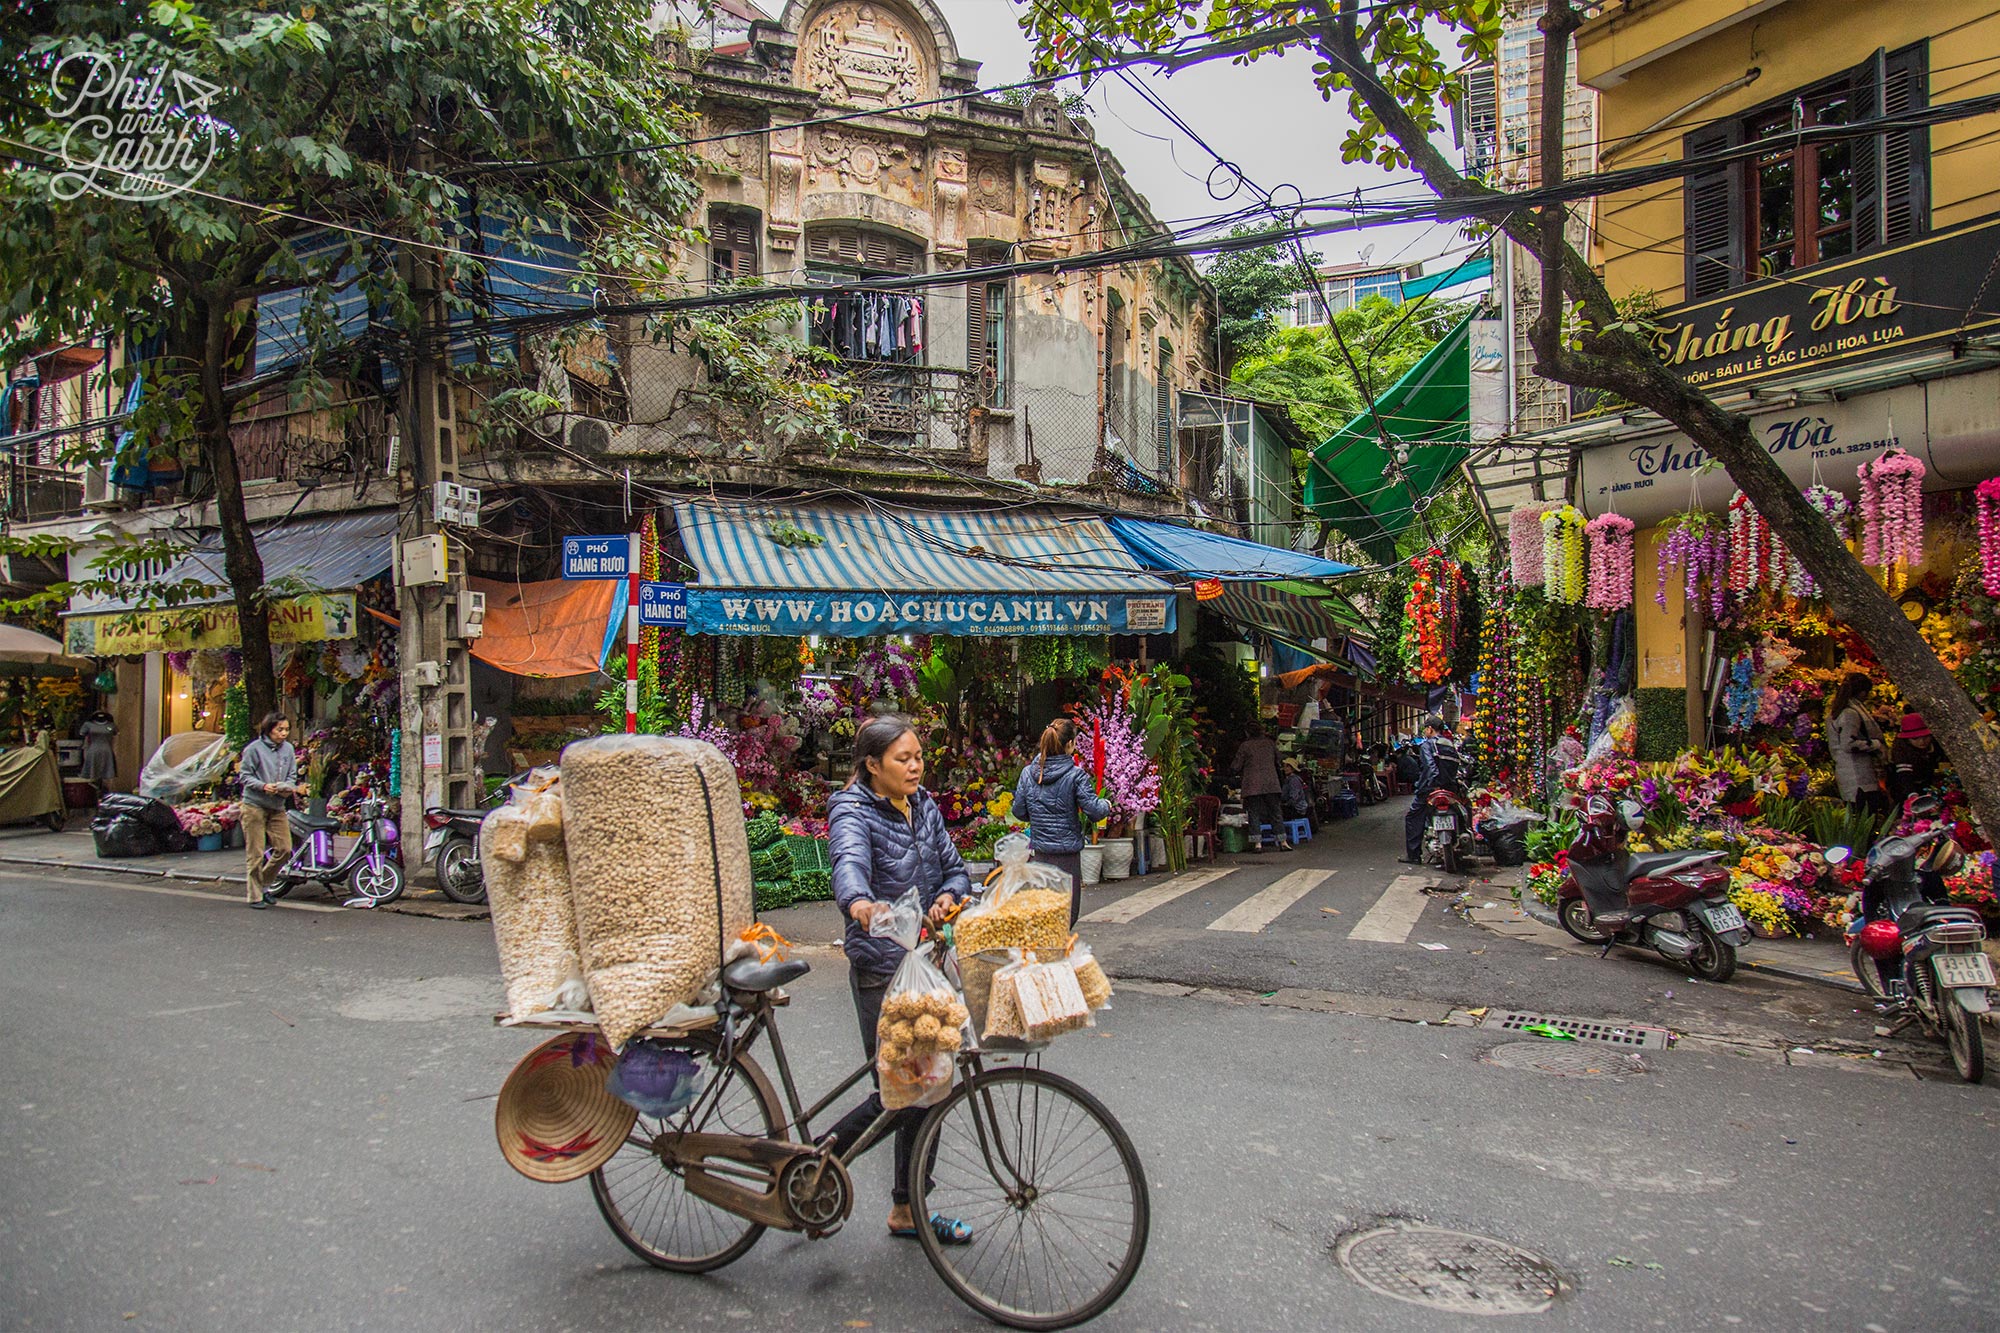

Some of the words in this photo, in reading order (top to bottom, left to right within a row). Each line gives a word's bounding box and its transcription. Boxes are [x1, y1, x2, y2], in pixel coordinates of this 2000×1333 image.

[1650, 306, 1794, 366] Thắng
[1808, 277, 1901, 331] Hà
[1716, 363, 1743, 378] BÁN
[1746, 354, 1763, 371] LẺ
[1768, 350, 1797, 367] CÁC
[1800, 341, 1833, 360] LOẠI
[1837, 335, 1867, 351] HOA
[1873, 325, 1904, 344] LỤA
[1766, 417, 1837, 454] Hà
[1846, 442, 1871, 453] 3829
[586, 541, 609, 553] PHỐ
[569, 555, 598, 573] HÀNG
[660, 589, 681, 601] PHỐ
[644, 601, 672, 619] HÀNG
